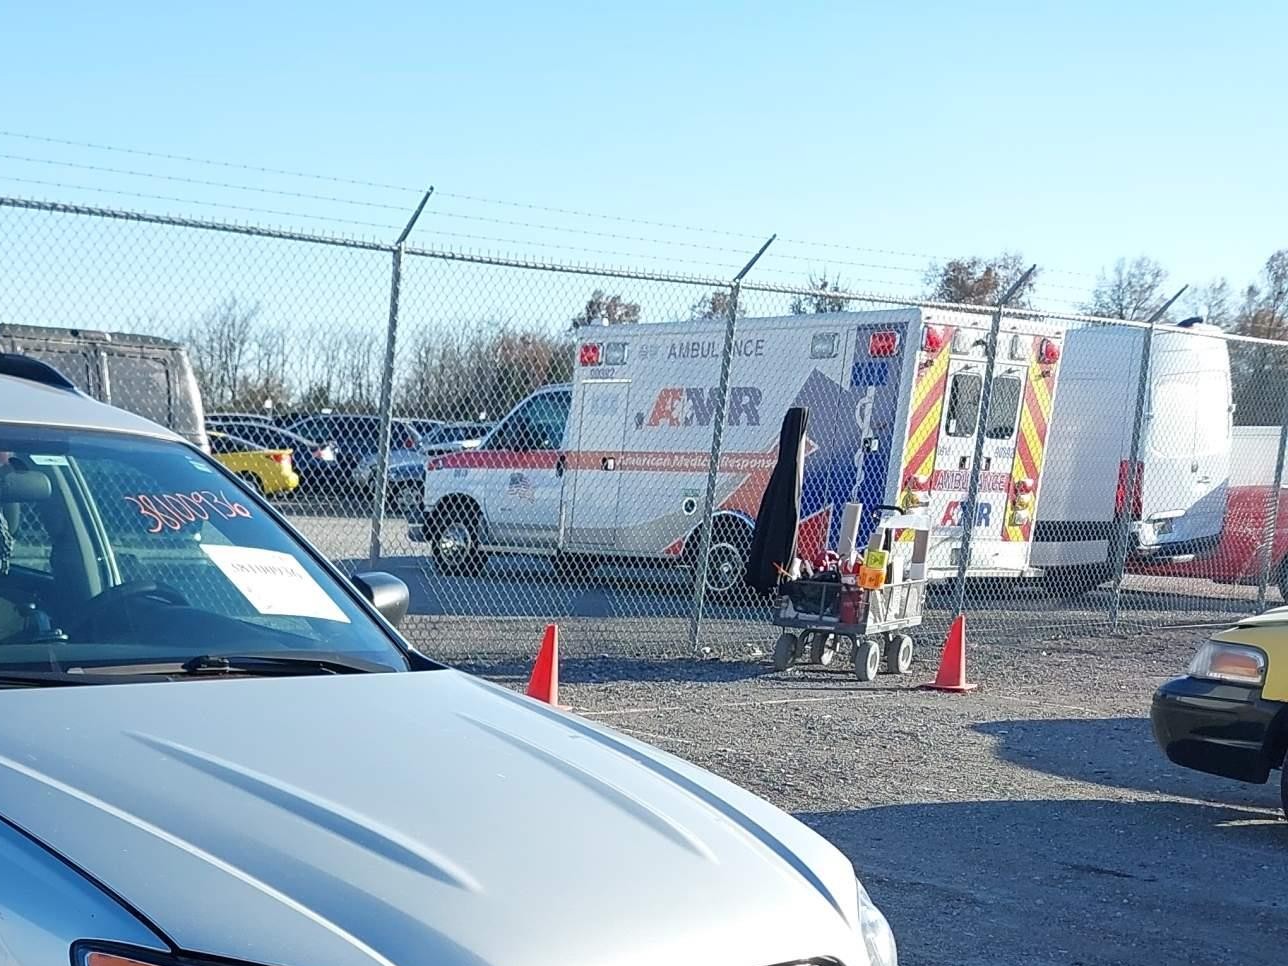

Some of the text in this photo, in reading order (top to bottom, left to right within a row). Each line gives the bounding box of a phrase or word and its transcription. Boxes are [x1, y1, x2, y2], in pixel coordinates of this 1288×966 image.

[667, 339, 765, 360] AMBULNCE
[645, 385, 763, 427] AMR
[123, 490, 253, 533] 38100936
